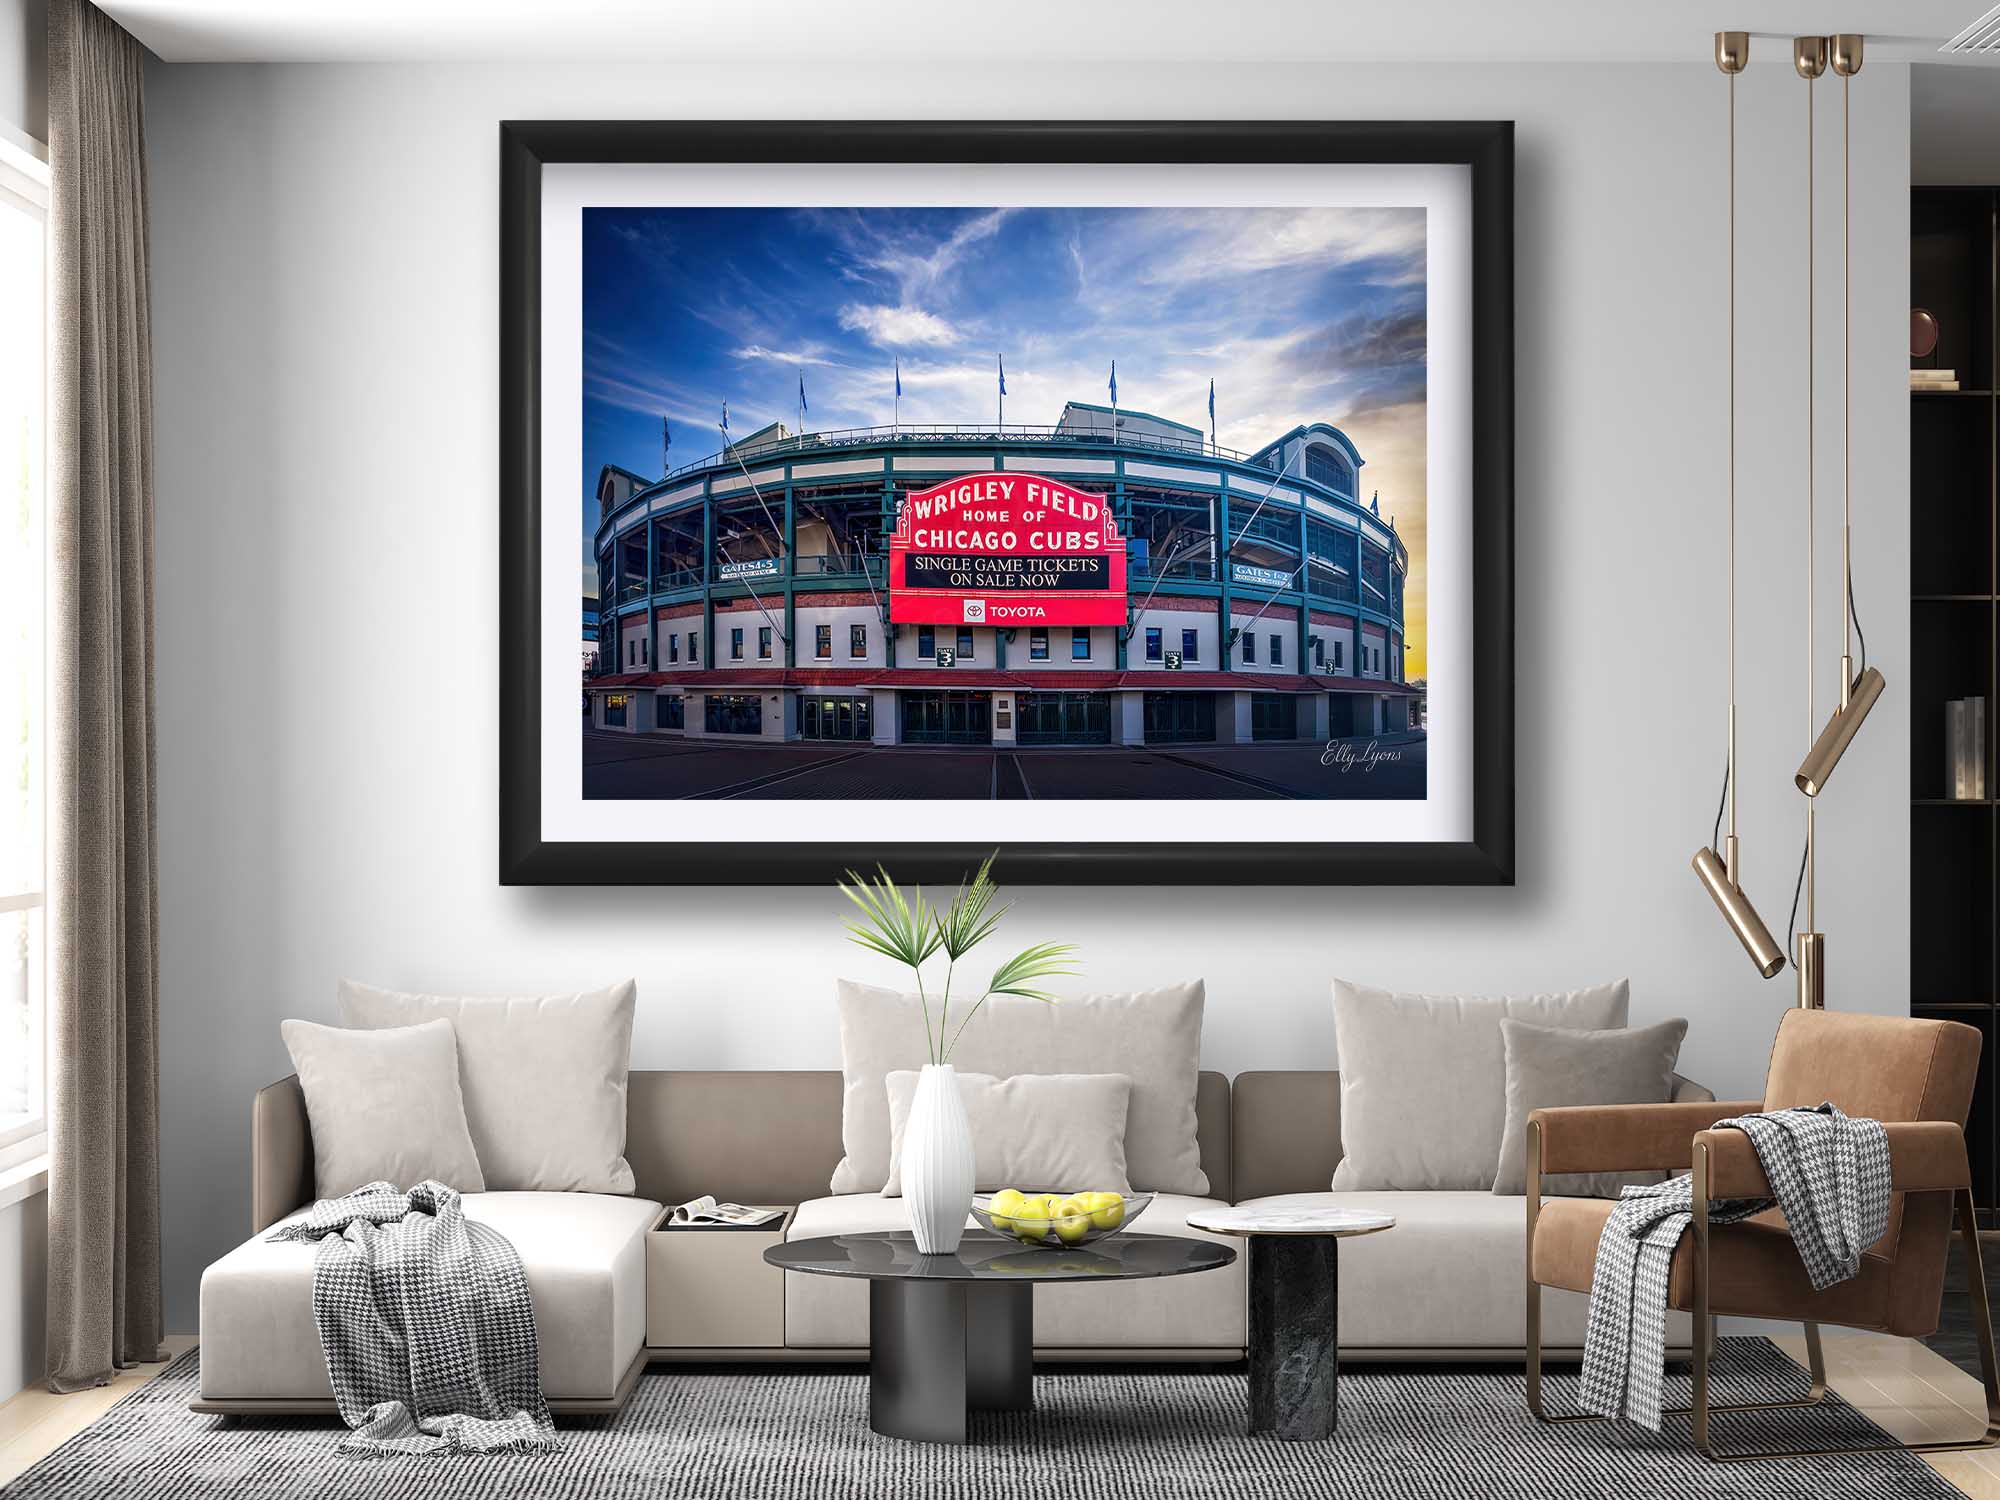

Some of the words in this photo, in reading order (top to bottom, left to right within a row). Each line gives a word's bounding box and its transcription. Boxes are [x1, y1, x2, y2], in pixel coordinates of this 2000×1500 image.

[914, 481, 1015, 520] WRIGLEY
[1027, 482, 1098, 522] FIELD
[963, 510, 1009, 523] HOME
[1022, 510, 1047, 523] OF
[914, 529, 1017, 551] CHICAGO
[1030, 531, 1099, 551] CUBS
[915, 556, 971, 571] SINGLE
[974, 558, 1023, 573] GAME
[1026, 558, 1099, 573] TICKETS
[1236, 566, 1271, 579] GATES
[950, 573, 973, 587] ON
[976, 573, 1015, 588] SALE
[1020, 574, 1060, 588] NOW
[990, 606, 1046, 617] TOYOTA
[940, 652, 952, 663] 3
[1167, 655, 1179, 666] 3
